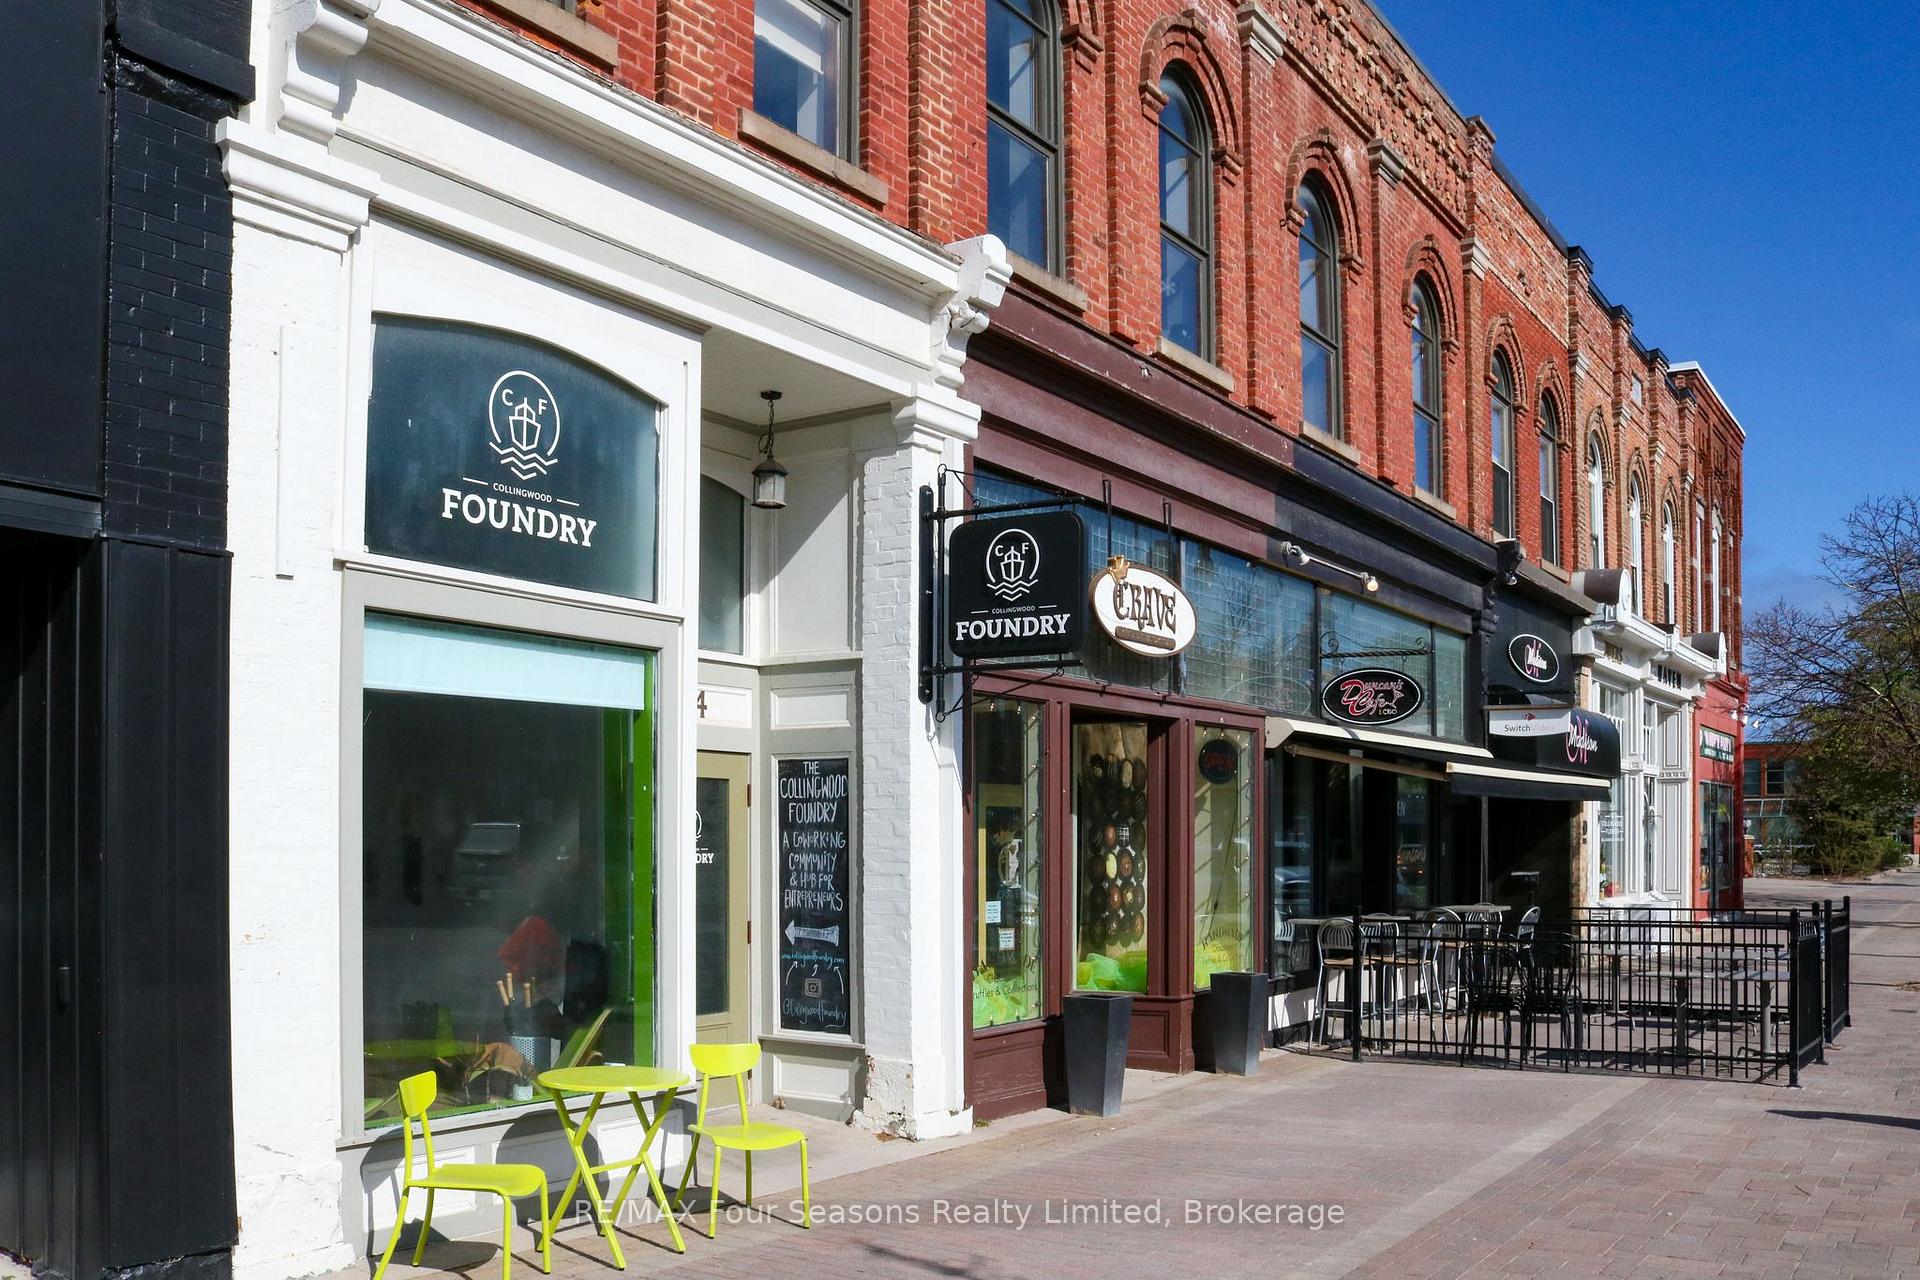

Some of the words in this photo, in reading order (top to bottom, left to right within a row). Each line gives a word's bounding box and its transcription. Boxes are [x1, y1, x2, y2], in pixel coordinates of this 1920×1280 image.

[501, 388, 513, 406] C
[538, 399, 548, 415] F
[493, 483, 552, 503] COLLINGWOOD
[441, 487, 597, 547] FOUNDRY
[995, 545, 1004, 557] C
[1021, 542, 1030, 554] F
[991, 605, 1036, 614] COLLINGWOOD
[1112, 581, 1176, 634] CRAVE
[955, 613, 1071, 641] FOUNDRY
[1340, 679, 1404, 705] Duncan's
[803, 761, 820, 775] THE
[780, 774, 848, 799] COLLINGWOOD
[789, 801, 838, 823] FOUNDRY
[782, 831, 790, 849] A
[790, 872, 797, 887] &
[800, 872, 817, 889] HUB
[818, 873, 834, 891] FOR
